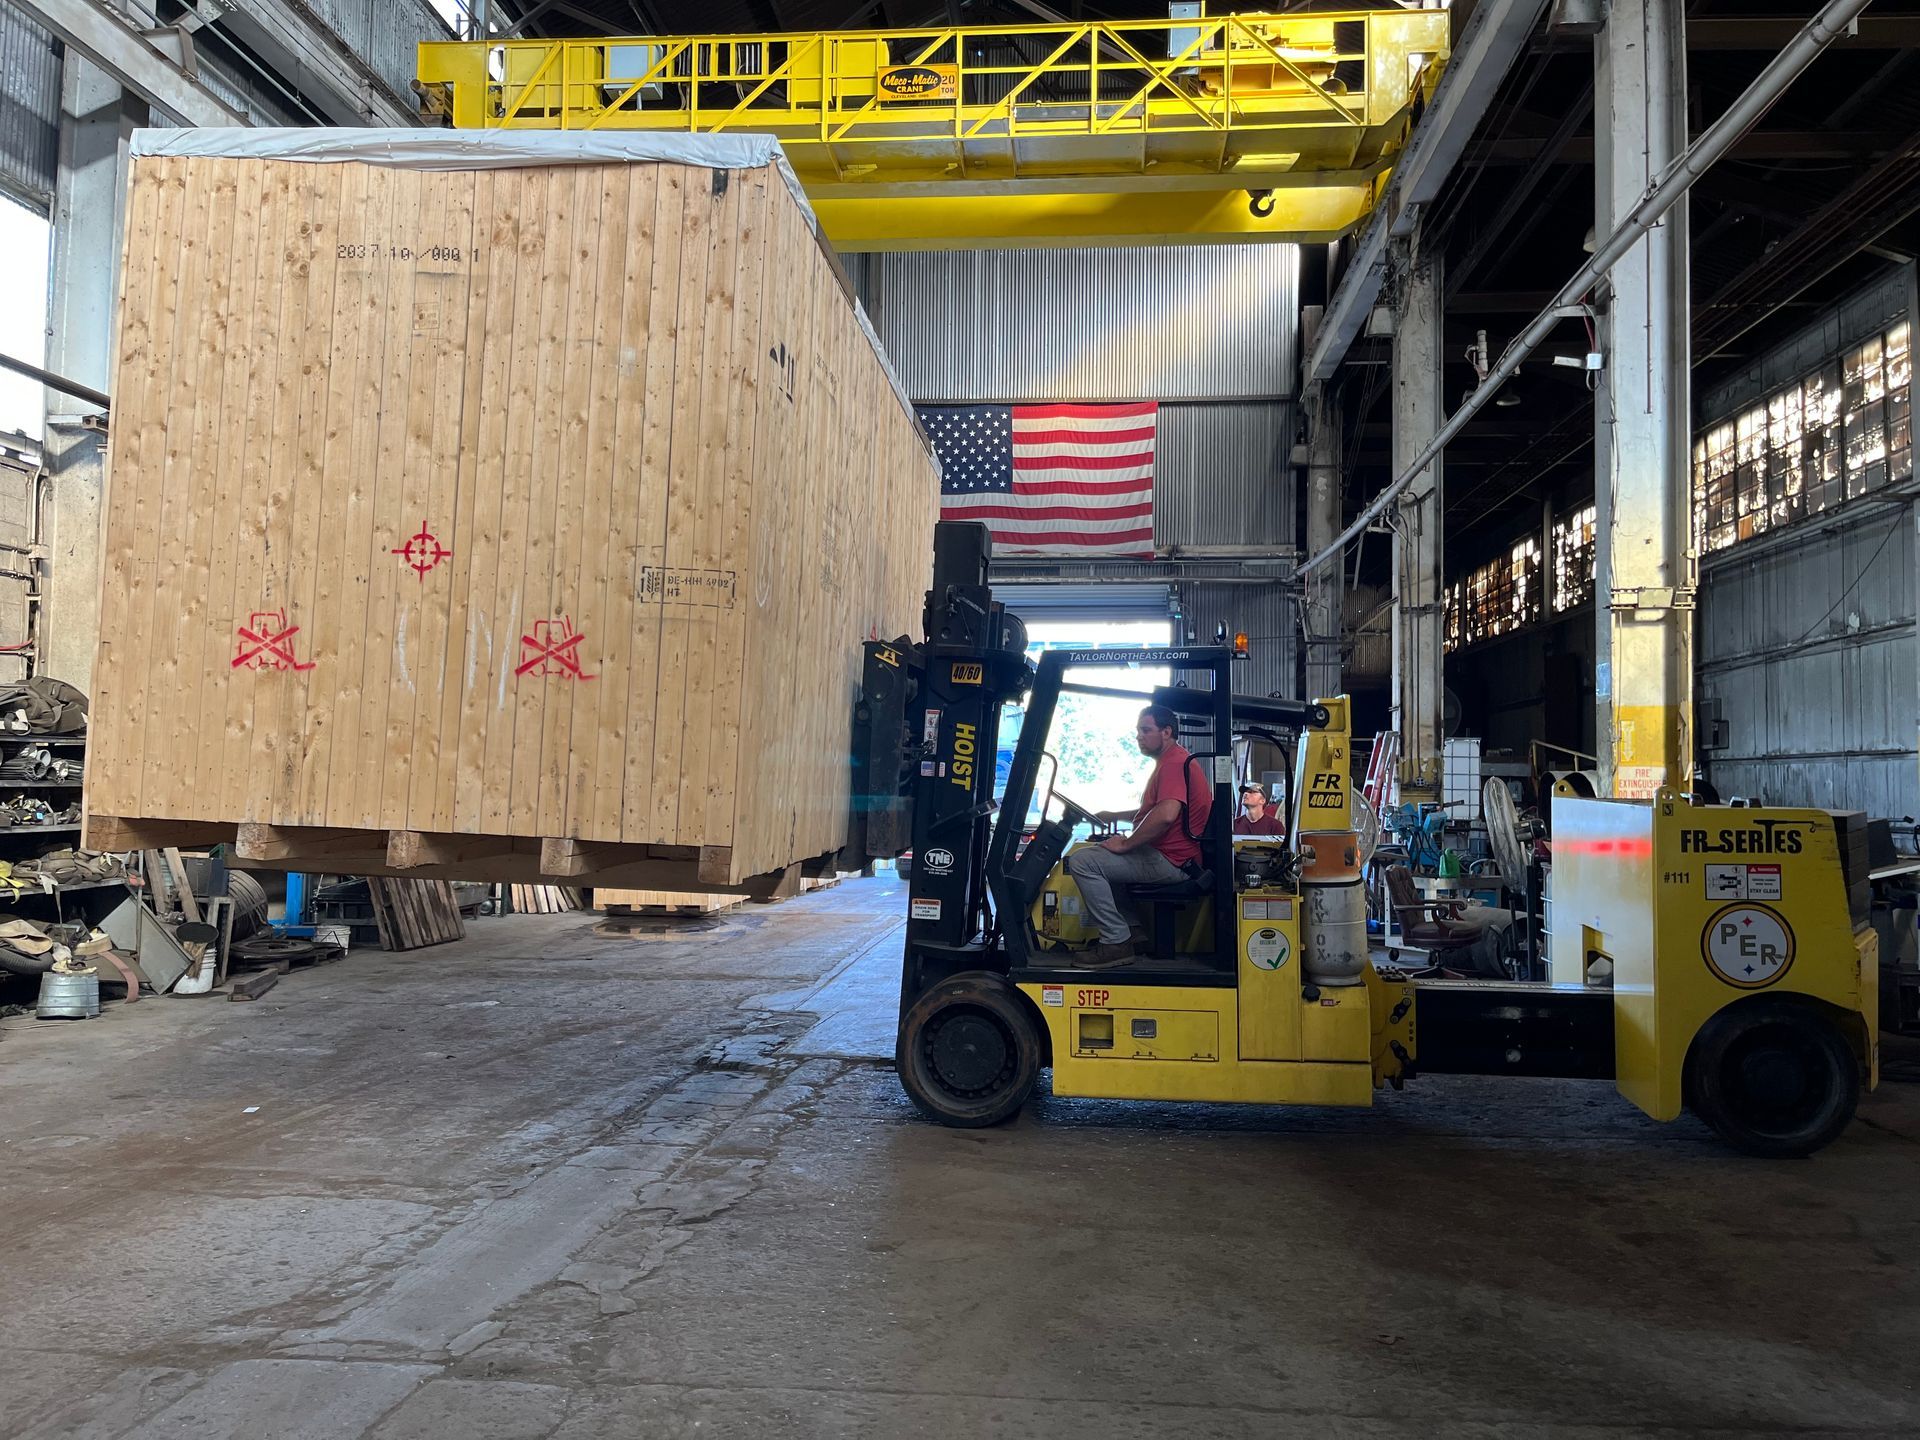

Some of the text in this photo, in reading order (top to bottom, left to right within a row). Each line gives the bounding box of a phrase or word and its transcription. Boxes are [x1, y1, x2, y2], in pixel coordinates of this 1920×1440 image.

[884, 74, 938, 87] Meco-Matic
[941, 75, 955, 85] 20
[953, 664, 981, 681] 40/60
[951, 722, 976, 791] HOIST
[1635, 768, 1650, 778] FIRE
[1312, 773, 1341, 789] FR
[1310, 794, 1342, 807] 40/60
[1680, 829, 1708, 853] FR
[928, 851, 951, 865] TNE
[1664, 871, 1690, 884] #111
[1077, 989, 1110, 1007] STEP
